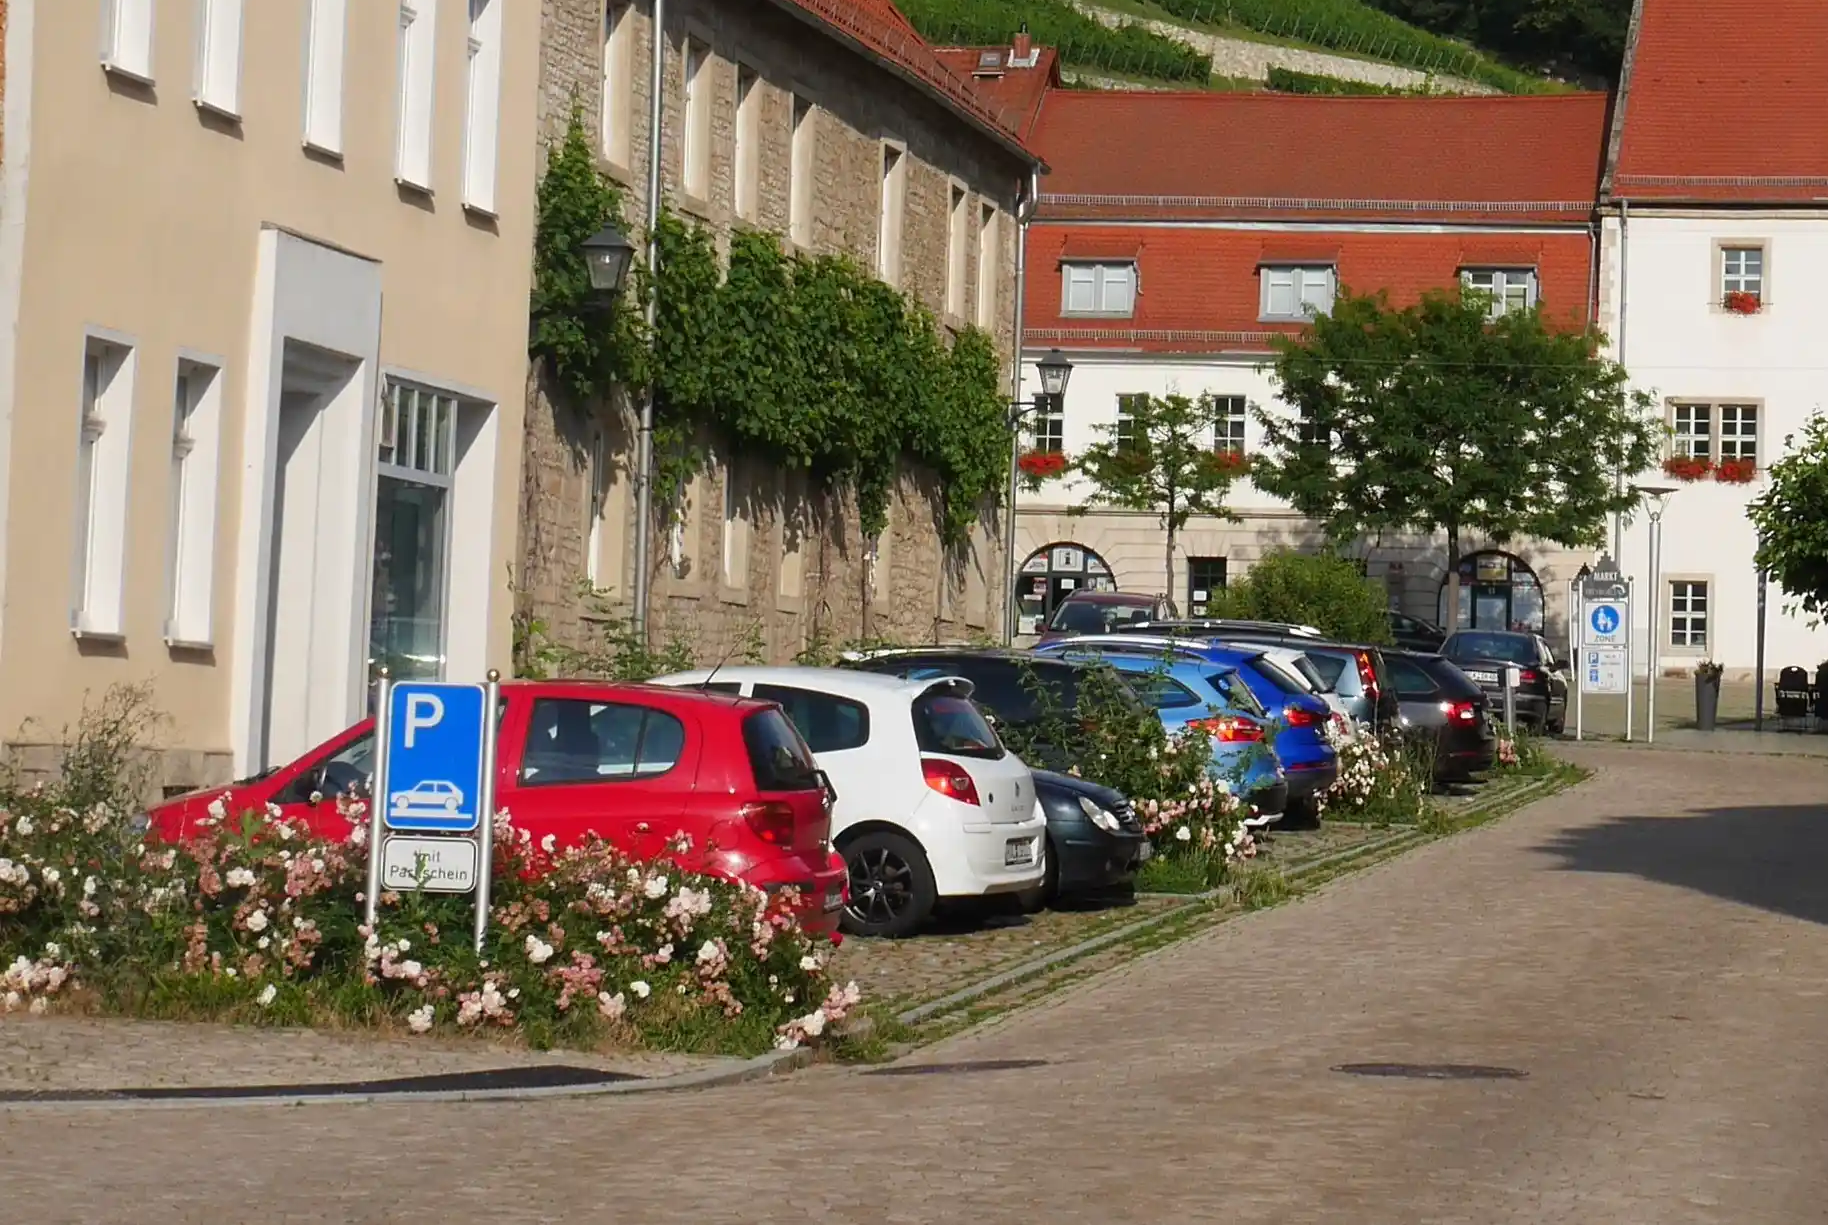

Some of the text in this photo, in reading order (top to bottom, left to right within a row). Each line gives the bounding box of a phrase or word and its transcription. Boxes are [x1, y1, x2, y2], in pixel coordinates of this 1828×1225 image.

[1594, 572, 1617, 581] MARKT
[1595, 635, 1616, 643] ZONE
[404, 693, 444, 748] P
[390, 865, 468, 880] Parschein
